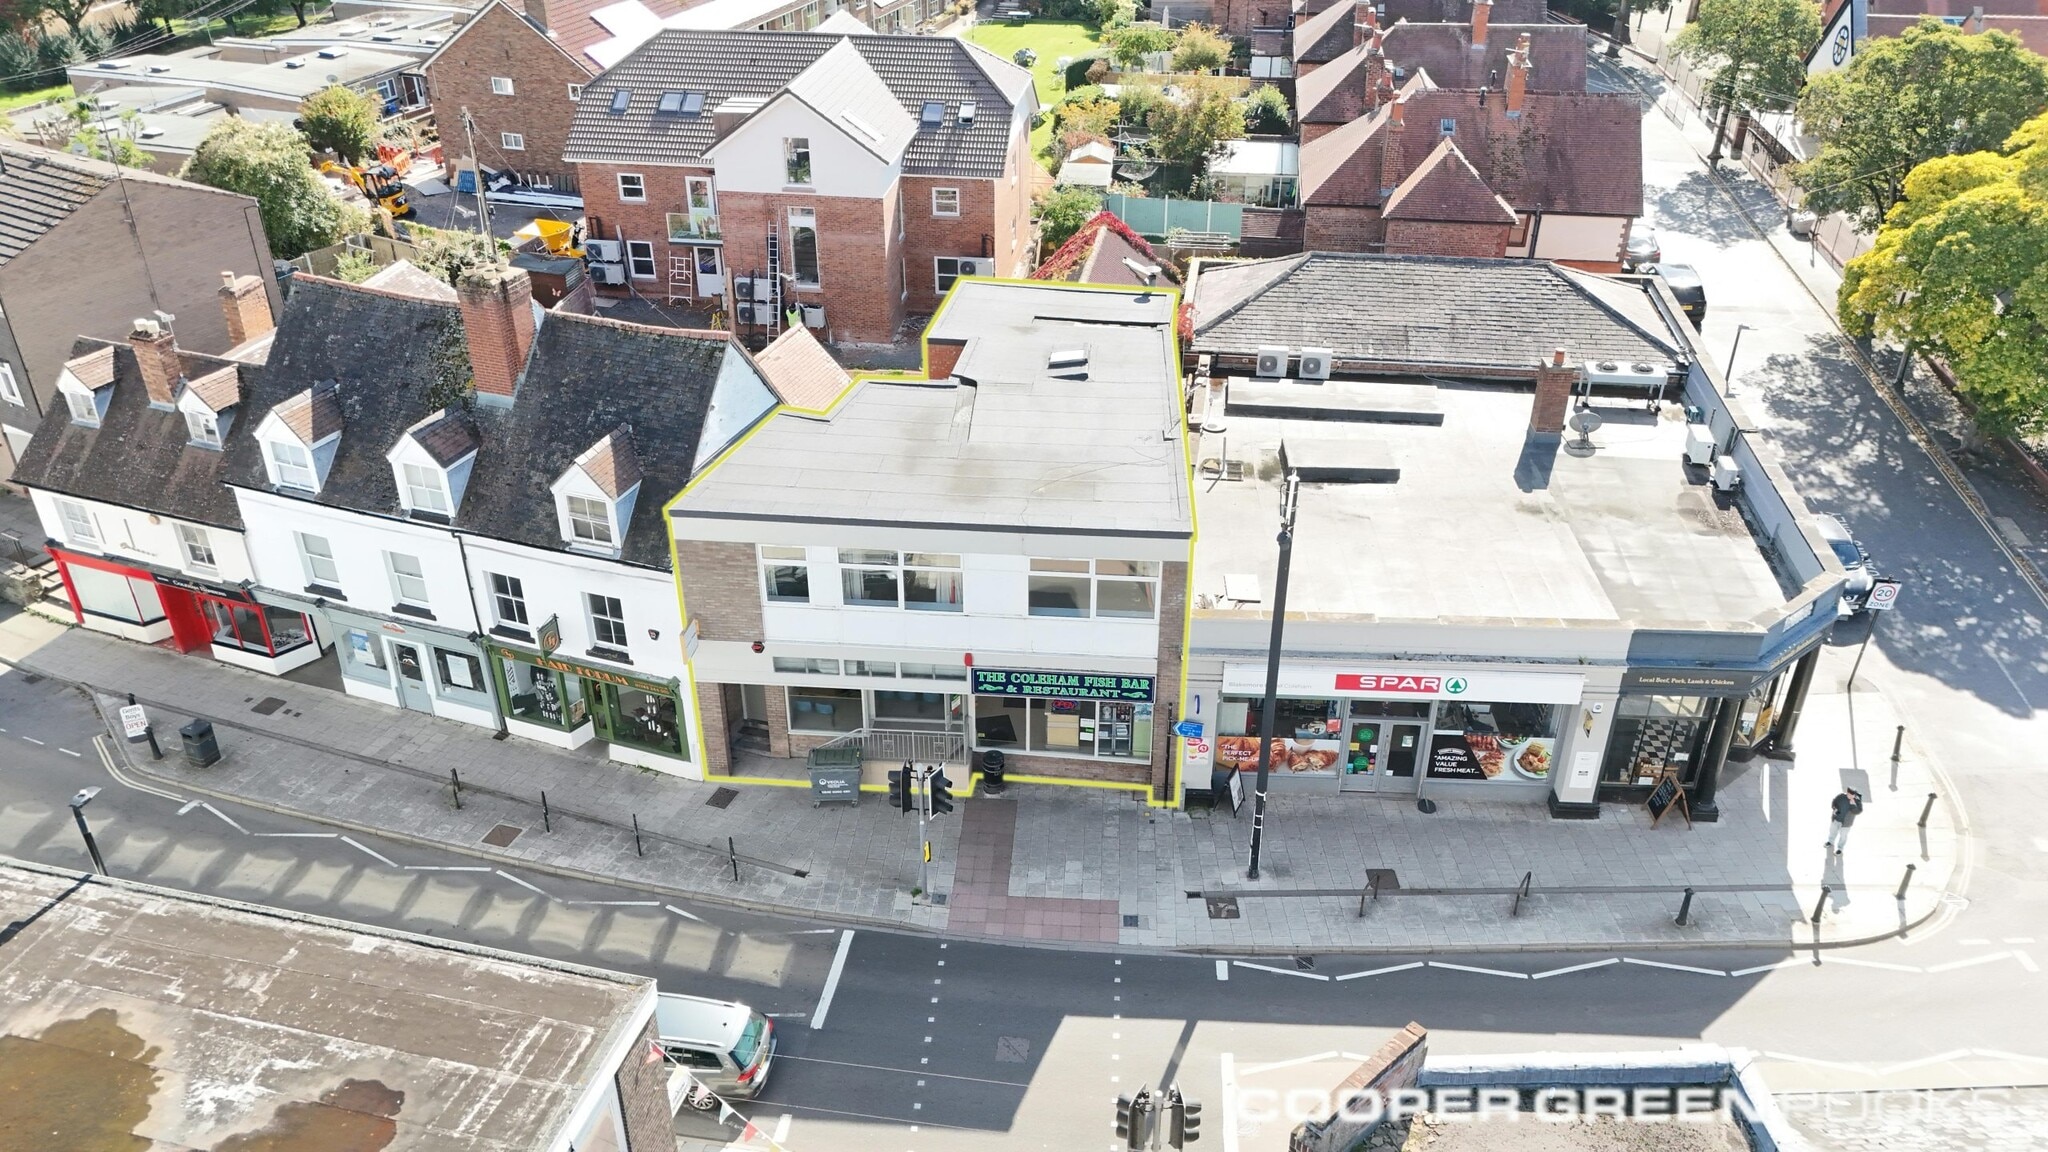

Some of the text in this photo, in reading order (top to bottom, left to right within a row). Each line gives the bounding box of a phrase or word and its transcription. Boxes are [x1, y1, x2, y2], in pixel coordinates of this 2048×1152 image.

[1876, 589, 1893, 597] 20
[976, 671, 1150, 690] THE COLEHAM FISH BAR
[1359, 676, 1440, 690] SPAR
[1006, 684, 1121, 698] & RESTAURANT
[121, 706, 142, 715] Gents
[125, 720, 147, 731] OPEN
